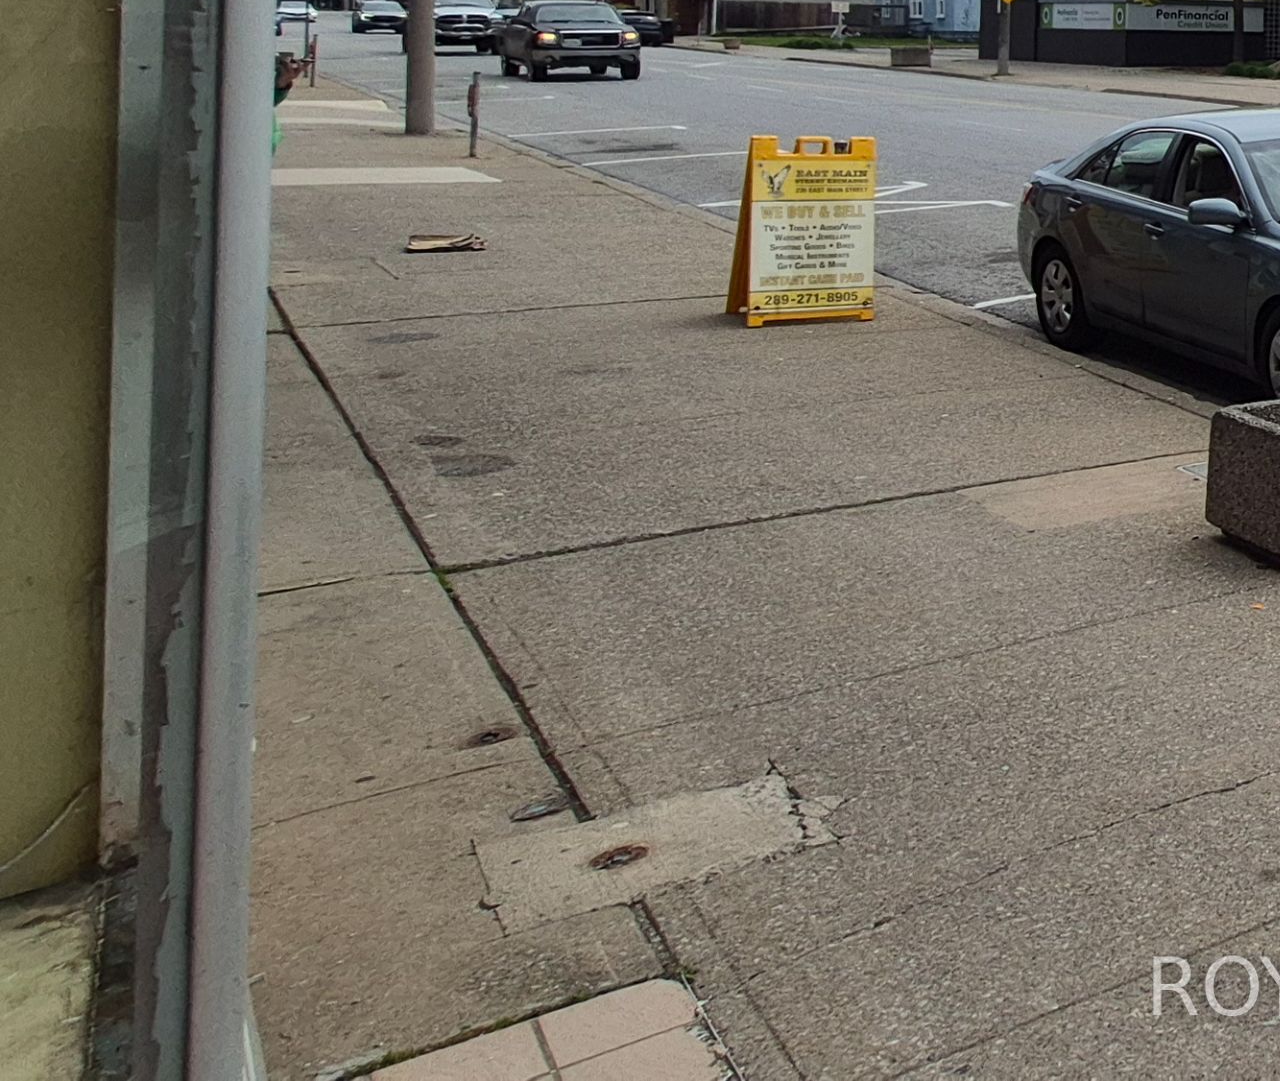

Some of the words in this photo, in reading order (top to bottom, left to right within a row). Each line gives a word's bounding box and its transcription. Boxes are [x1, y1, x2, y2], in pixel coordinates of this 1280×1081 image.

[1156, 8, 1229, 21] PenFinancial
[796, 170, 829, 178] EAST
[832, 170, 868, 178] MAIN
[761, 206, 783, 219] WE
[787, 206, 815, 219] BUY
[819, 205, 830, 218] &
[833, 204, 866, 218] SELL
[764, 291, 858, 306] 289-271-8905
